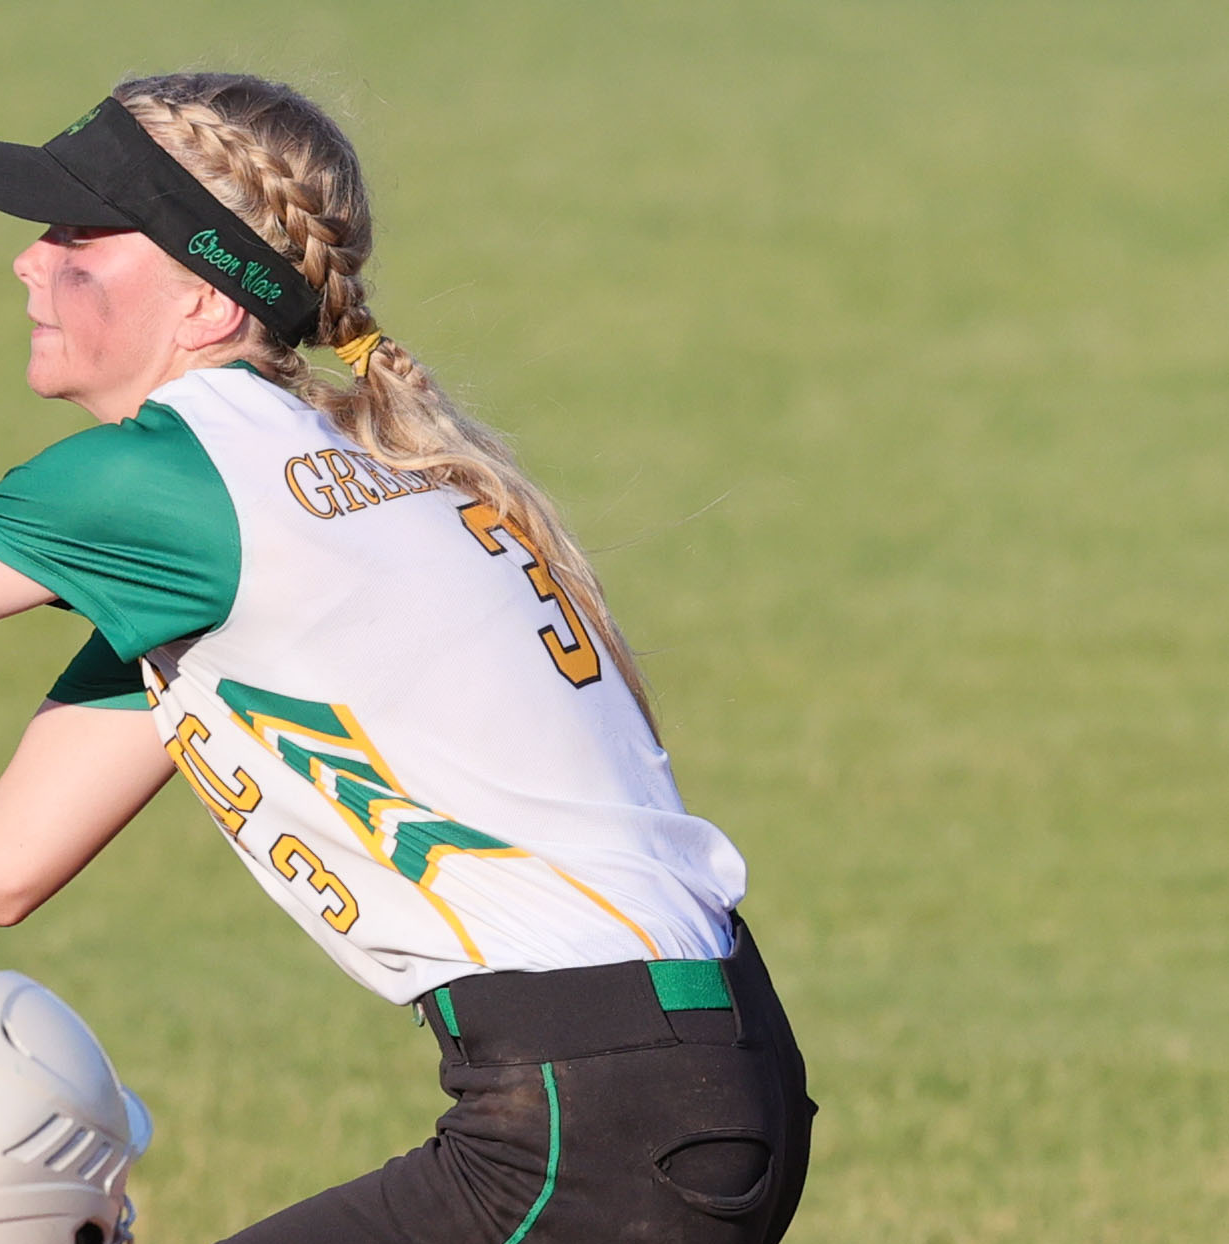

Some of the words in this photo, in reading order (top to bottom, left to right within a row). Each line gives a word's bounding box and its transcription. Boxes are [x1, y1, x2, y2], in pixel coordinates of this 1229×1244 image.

[188, 228, 242, 277] Green
[241, 260, 283, 305] Wave
[284, 448, 439, 520] GREE
[456, 500, 603, 690] 3
[268, 832, 360, 935] 3
